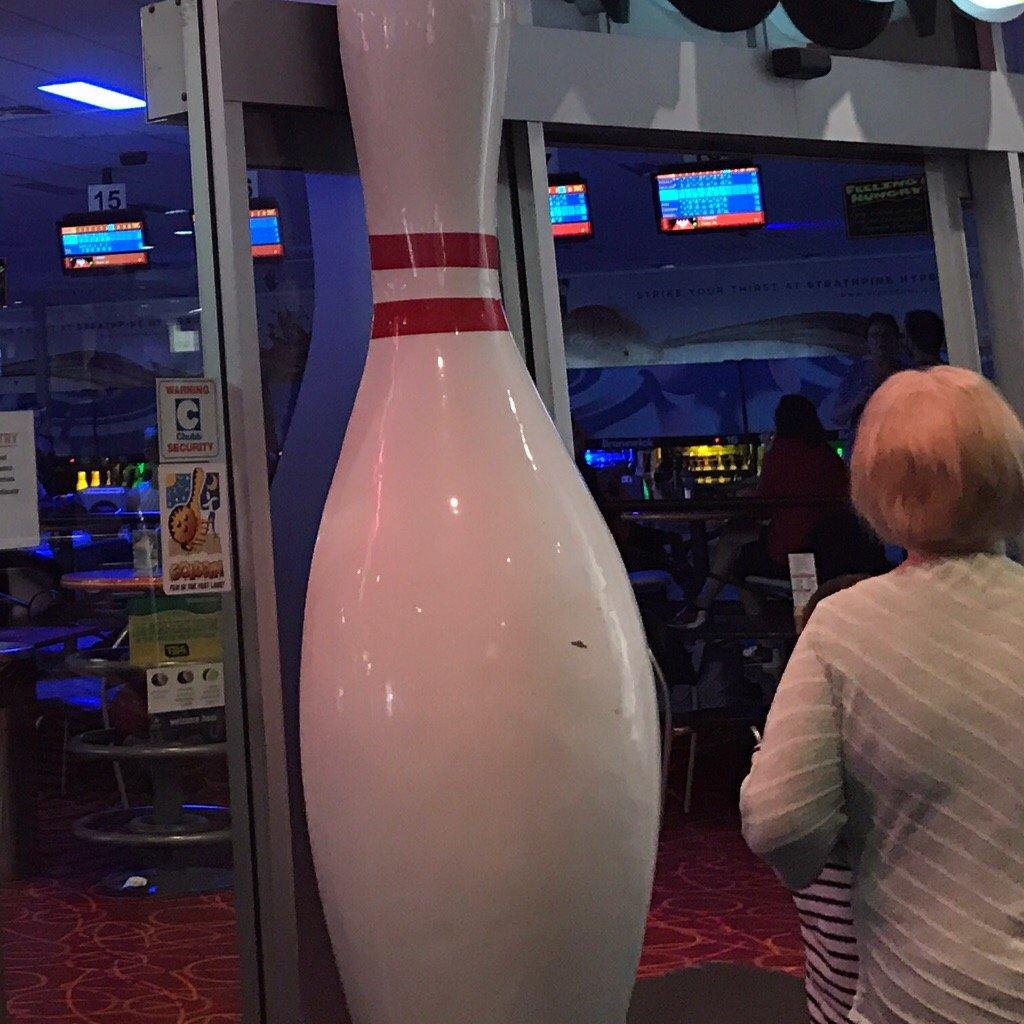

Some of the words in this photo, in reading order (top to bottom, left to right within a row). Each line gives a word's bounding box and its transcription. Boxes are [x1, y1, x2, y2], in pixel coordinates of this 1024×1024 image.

[94, 190, 121, 210] 15
[166, 385, 210, 395] WARNING
[167, 442, 214, 453] SECURITY
